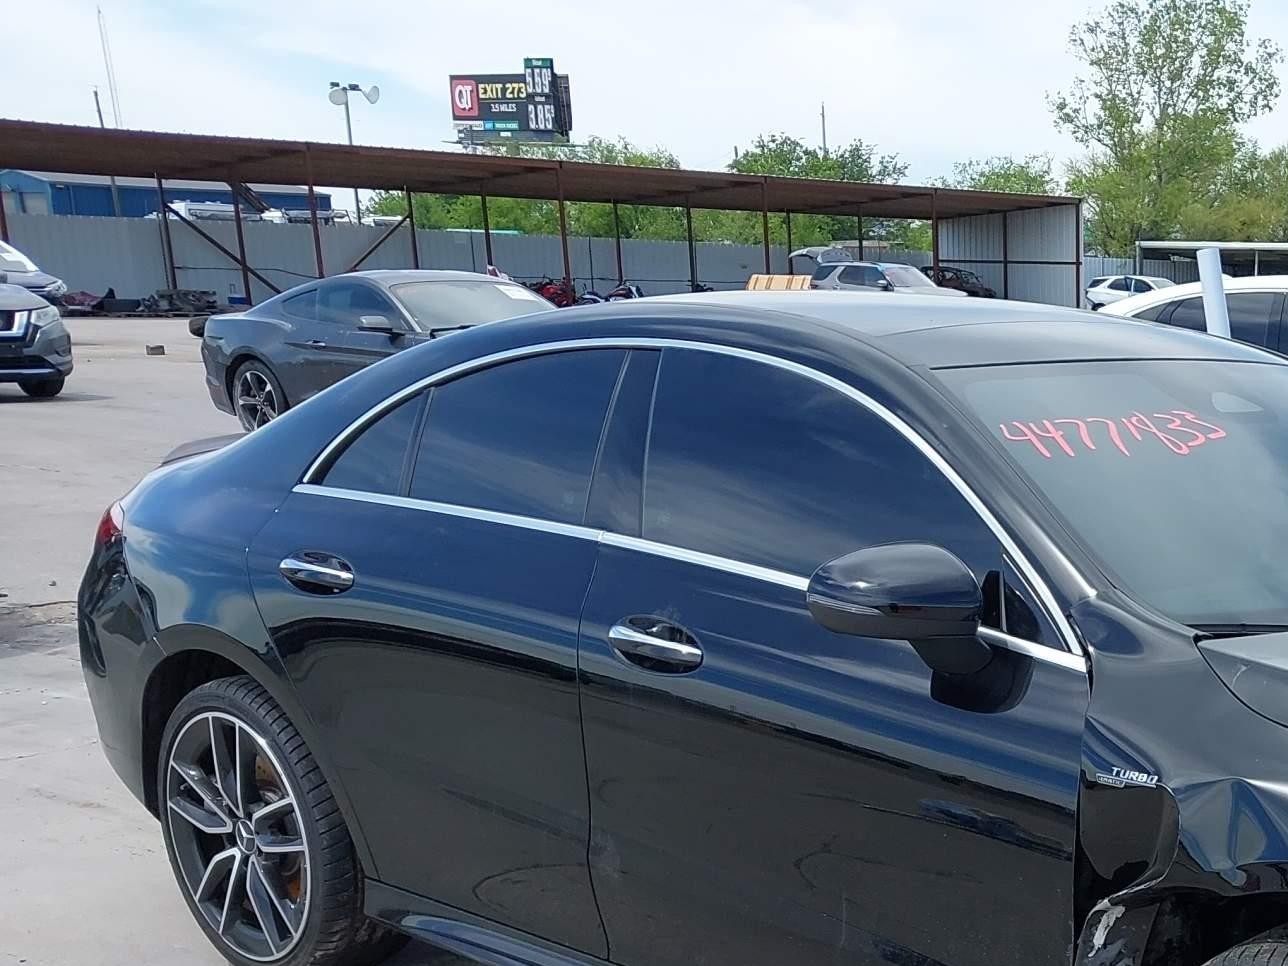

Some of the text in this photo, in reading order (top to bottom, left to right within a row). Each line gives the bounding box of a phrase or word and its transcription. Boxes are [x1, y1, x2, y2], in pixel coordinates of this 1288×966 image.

[454, 84, 472, 110] QT
[478, 82, 527, 99] EXIT 273
[500, 103, 517, 112] MILES
[1111, 766, 1159, 785] TURBO
